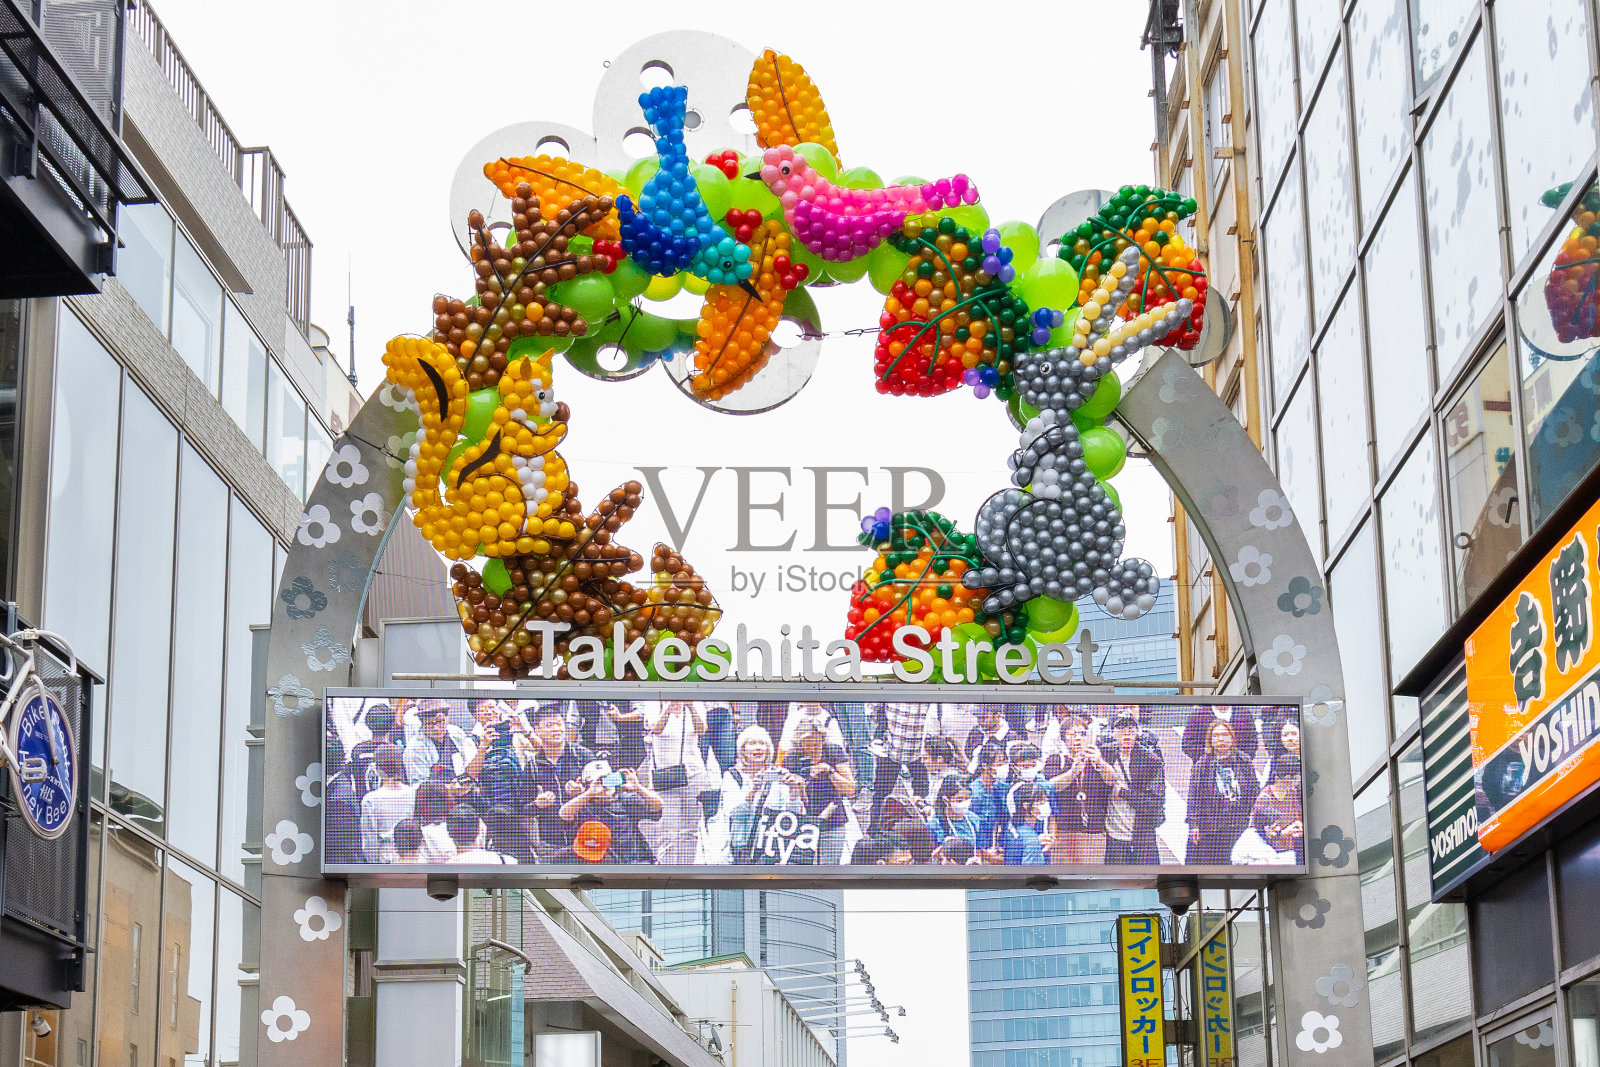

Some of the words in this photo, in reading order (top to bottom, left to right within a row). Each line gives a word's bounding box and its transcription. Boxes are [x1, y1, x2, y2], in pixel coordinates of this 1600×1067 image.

[1509, 523, 1600, 715] 吉野
[526, 623, 863, 683] Takeshita
[891, 626, 1105, 685] Street
[21, 705, 46, 738] Bike
[46, 800, 67, 825] Bee
[1126, 918, 1160, 1054] コインロッカー
